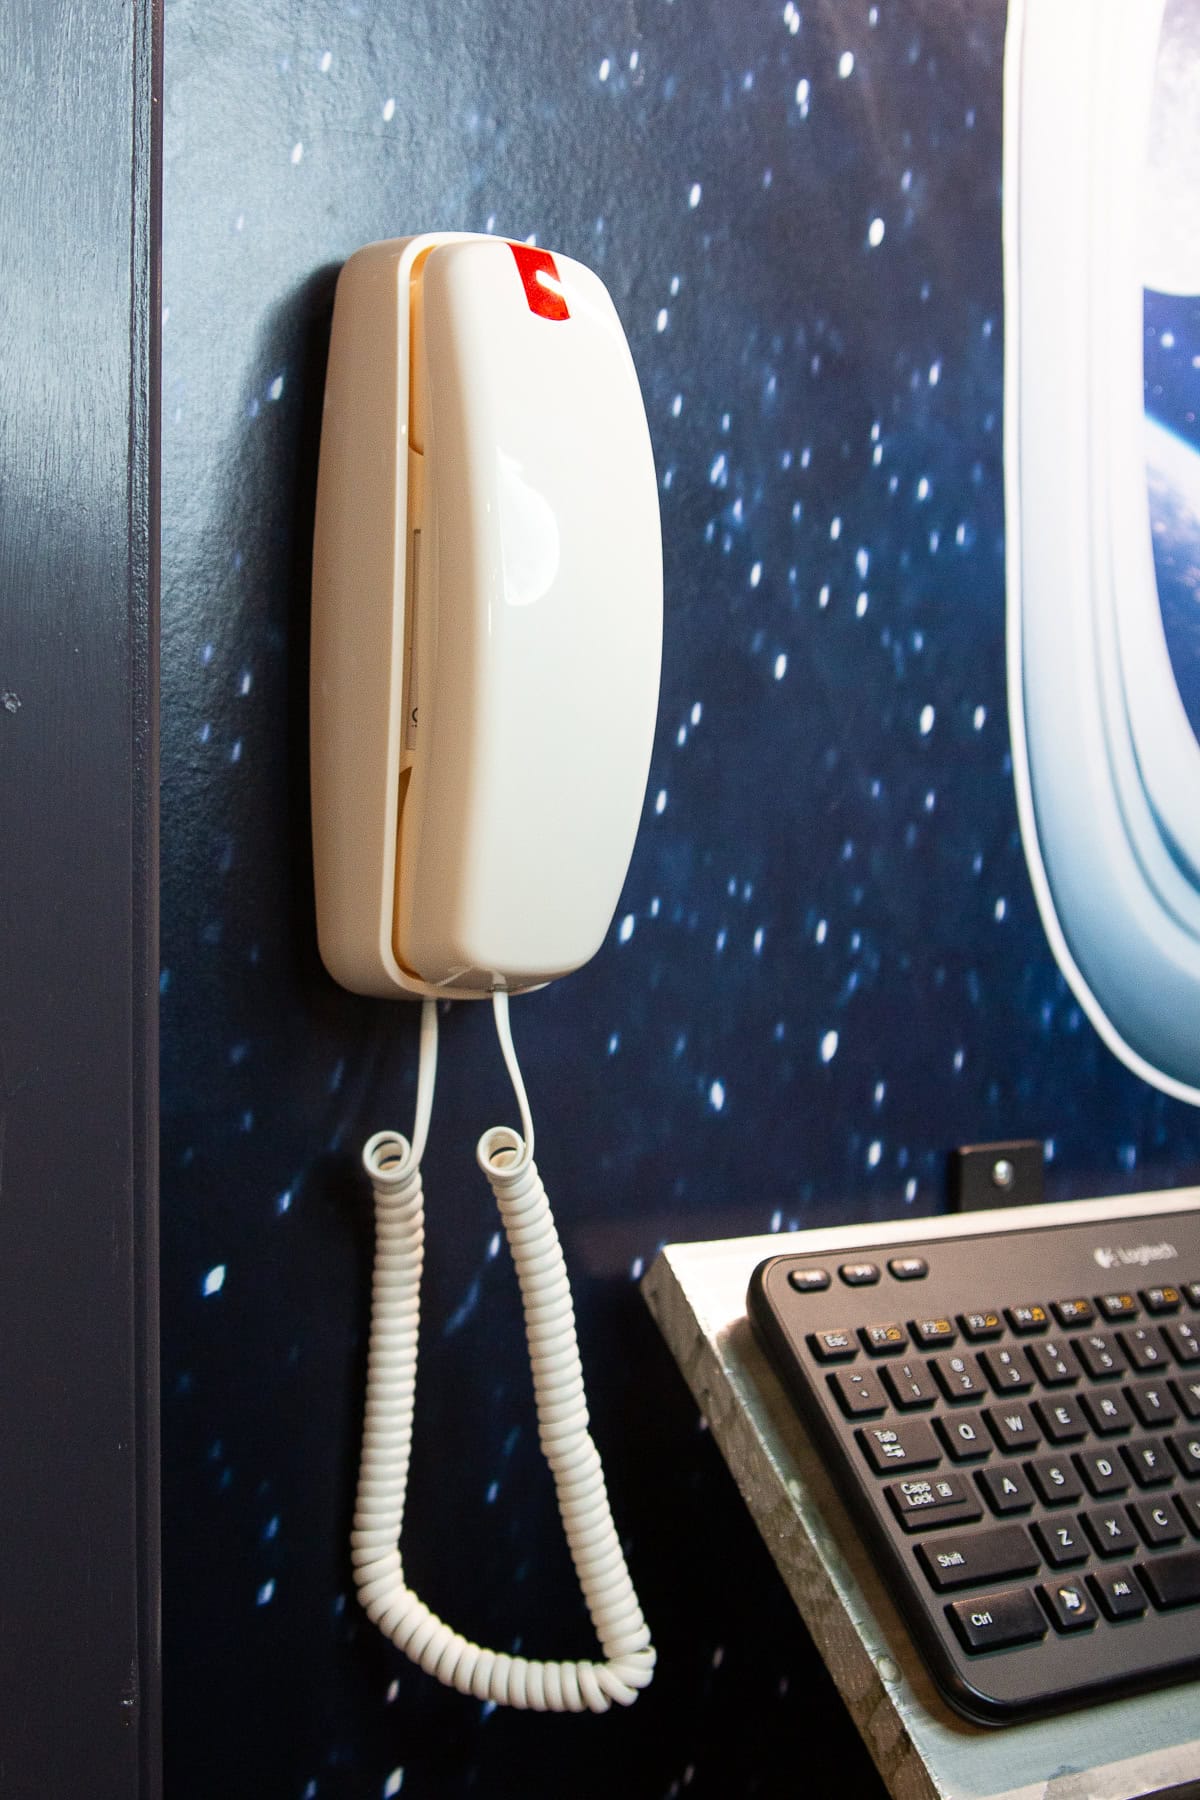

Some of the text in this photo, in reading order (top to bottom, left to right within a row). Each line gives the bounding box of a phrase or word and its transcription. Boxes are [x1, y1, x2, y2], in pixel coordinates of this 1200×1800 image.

[1100, 1353, 1113, 1367] 5
[961, 1375, 973, 1389] 2
[1009, 1368, 1021, 1382] 3
[1147, 1391, 1160, 1407] T
[1055, 1407, 1071, 1424] E
[1100, 1399, 1117, 1416] R
[958, 1423, 976, 1440] Q
[1004, 1415, 1023, 1432] W
[874, 1429, 898, 1443] Tab
[1143, 1450, 1155, 1467] F
[1096, 1459, 1112, 1476] D
[1049, 1468, 1065, 1485] S
[901, 1481, 931, 1496] Caps
[1002, 1477, 1018, 1494] A
[906, 1492, 936, 1506] Lock
[1152, 1509, 1168, 1526] C
[1105, 1520, 1121, 1536] X
[1057, 1528, 1073, 1546] Z
[936, 1551, 965, 1567] Shift
[971, 1612, 993, 1626] Ctrl
